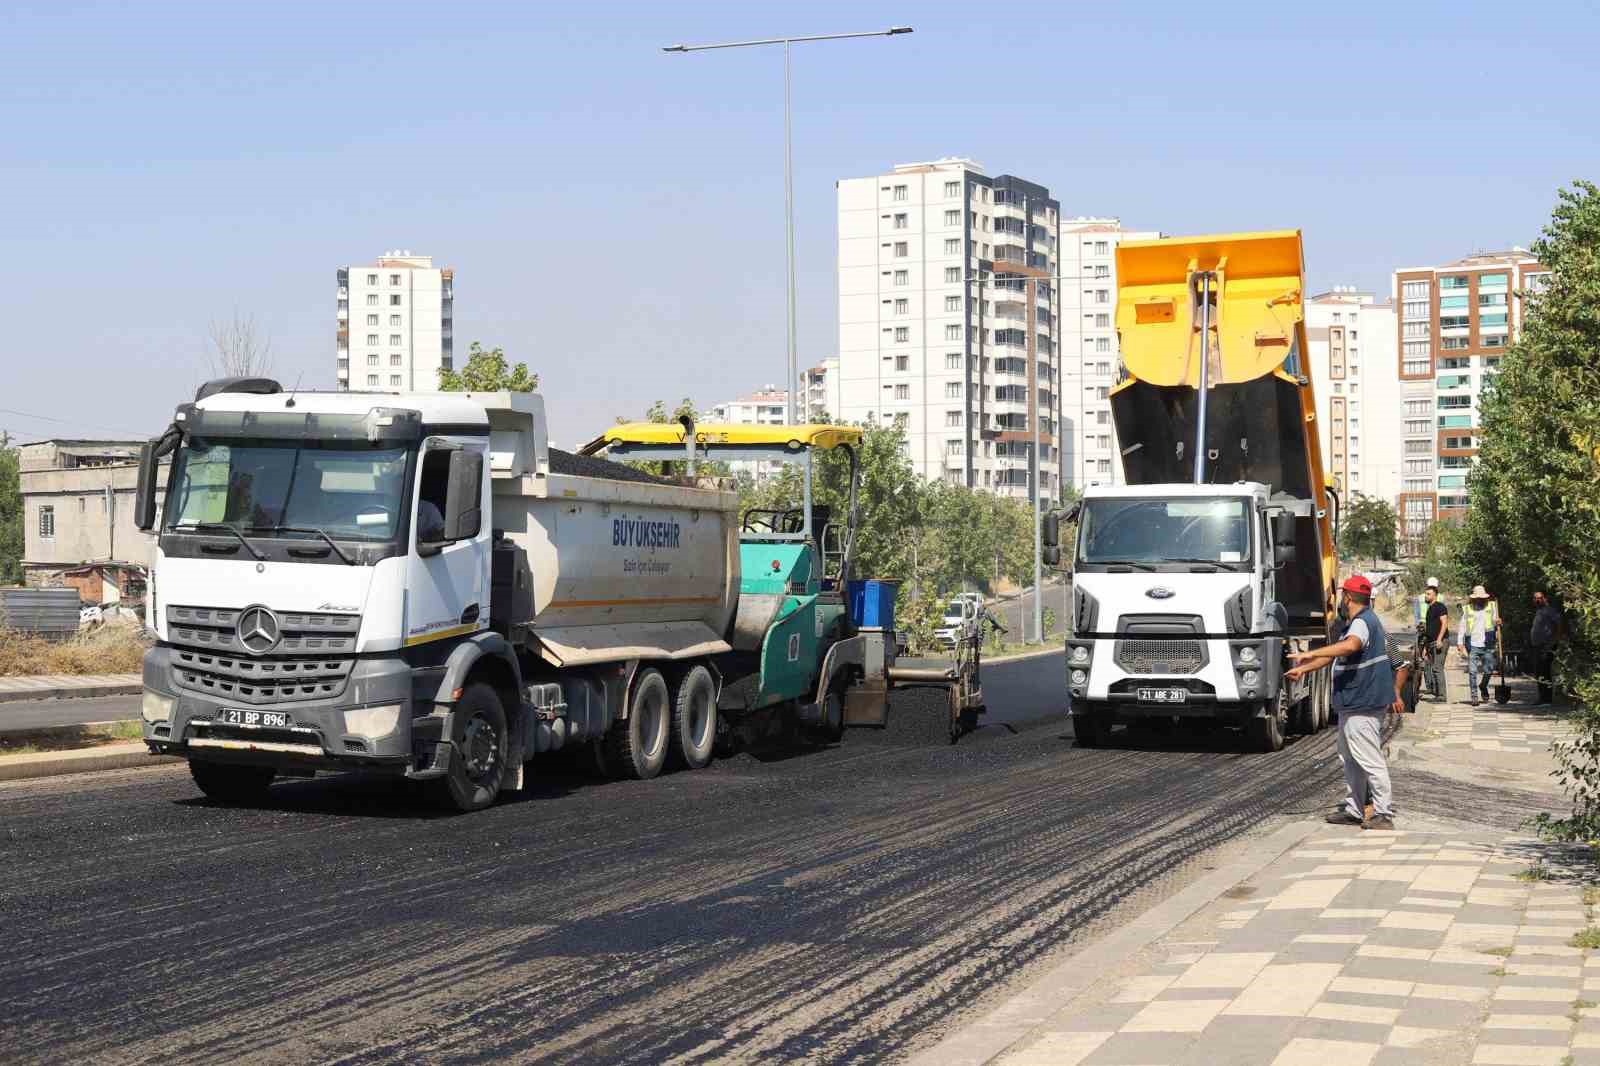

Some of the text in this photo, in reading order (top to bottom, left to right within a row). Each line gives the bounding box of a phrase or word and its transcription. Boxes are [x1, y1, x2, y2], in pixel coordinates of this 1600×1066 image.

[612, 513, 680, 554] BÜYÜKŞEHİR
[1142, 691, 1151, 699] 21
[229, 711, 284, 727] 21 BP 896
